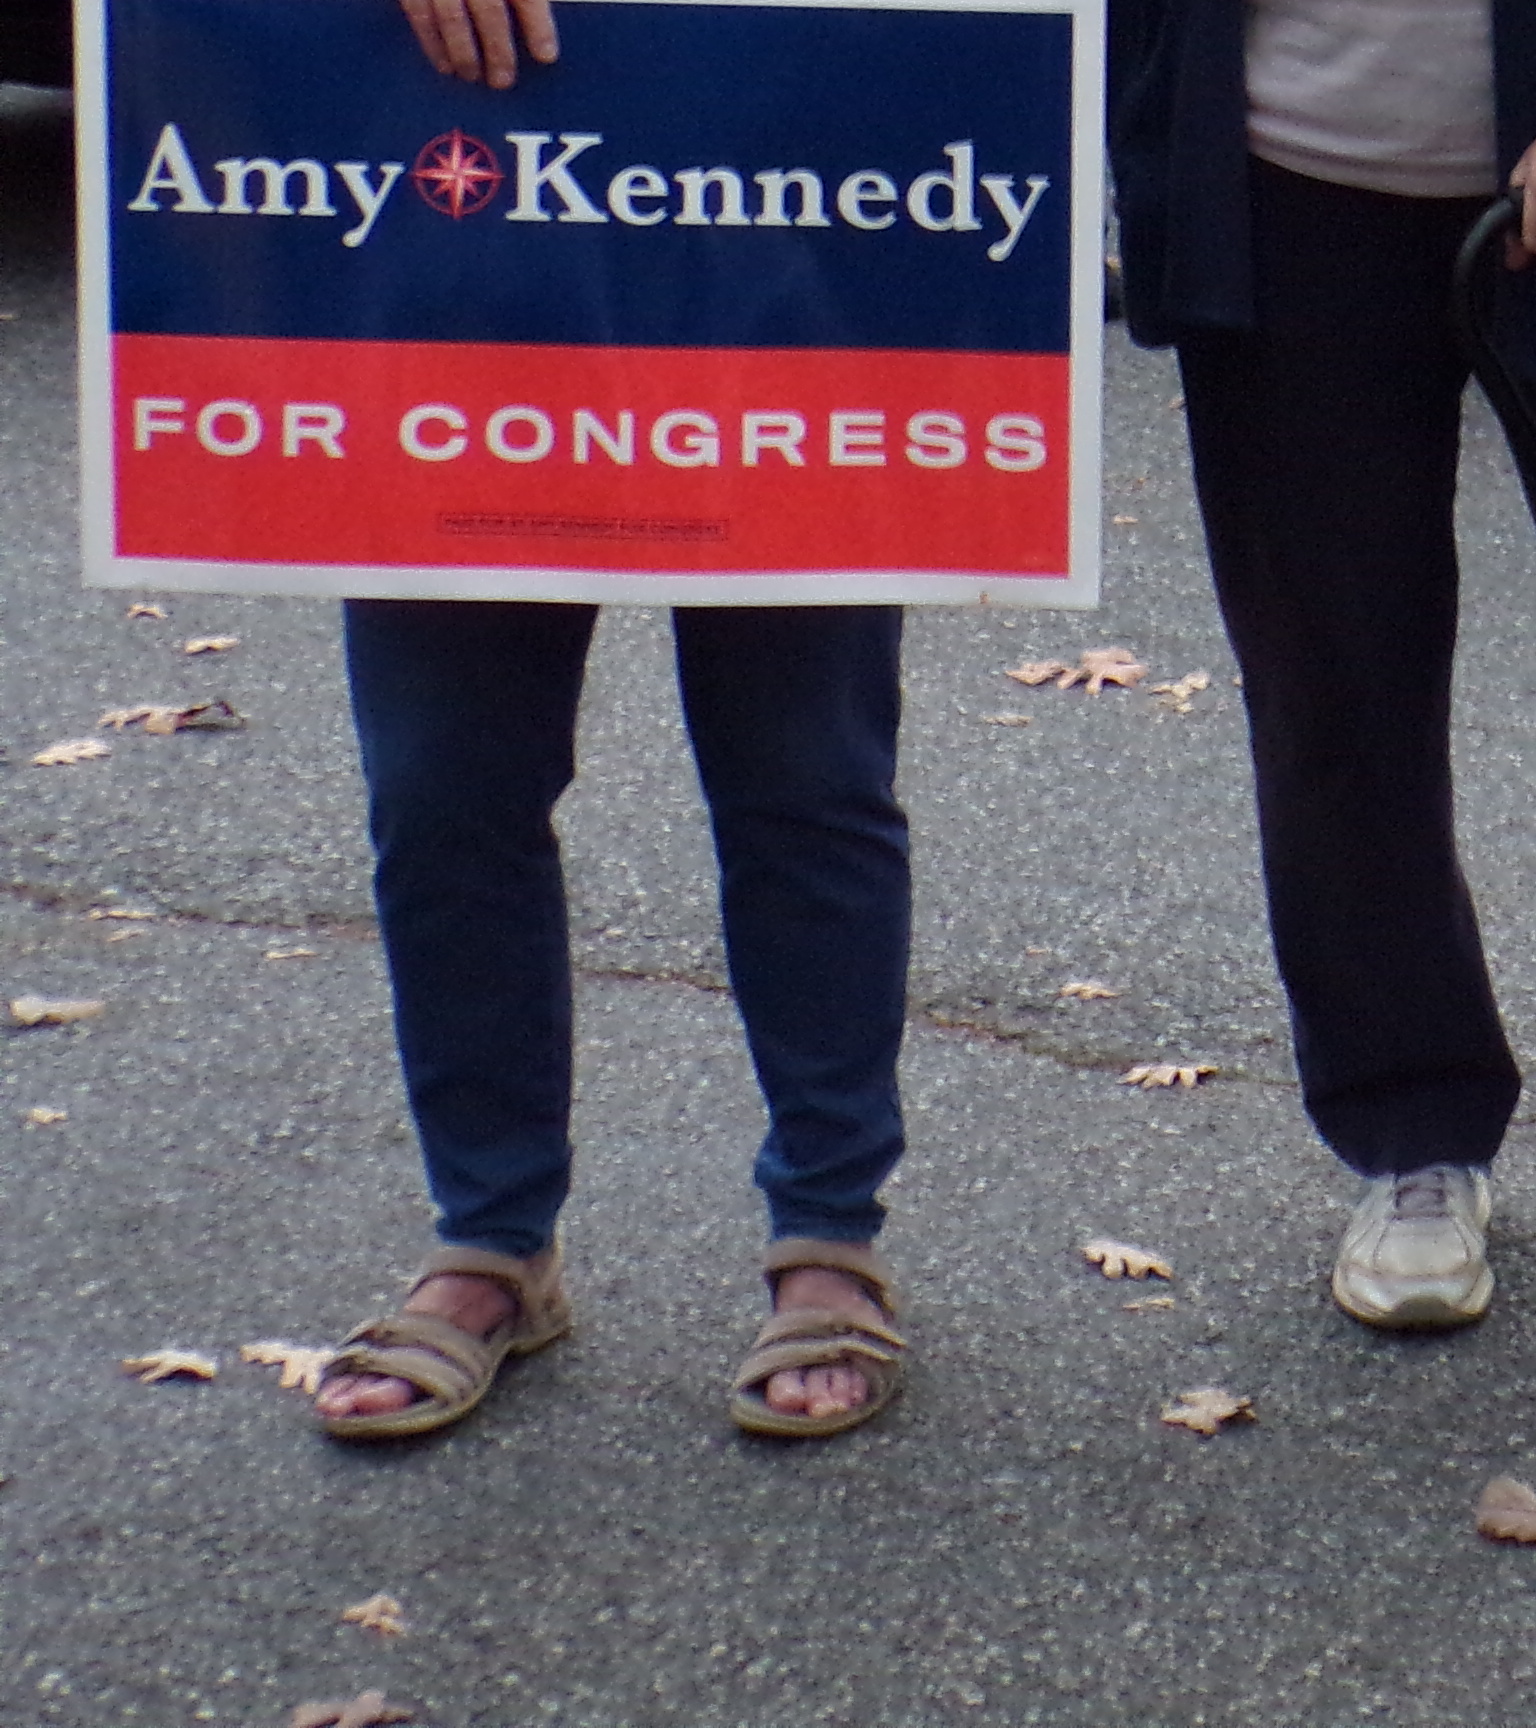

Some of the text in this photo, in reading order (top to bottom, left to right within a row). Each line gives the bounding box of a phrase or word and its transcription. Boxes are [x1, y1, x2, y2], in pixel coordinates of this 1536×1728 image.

[127, 122, 1050, 263] Amy Kennedy
[132, 397, 1049, 473] FOR CONGRESS
